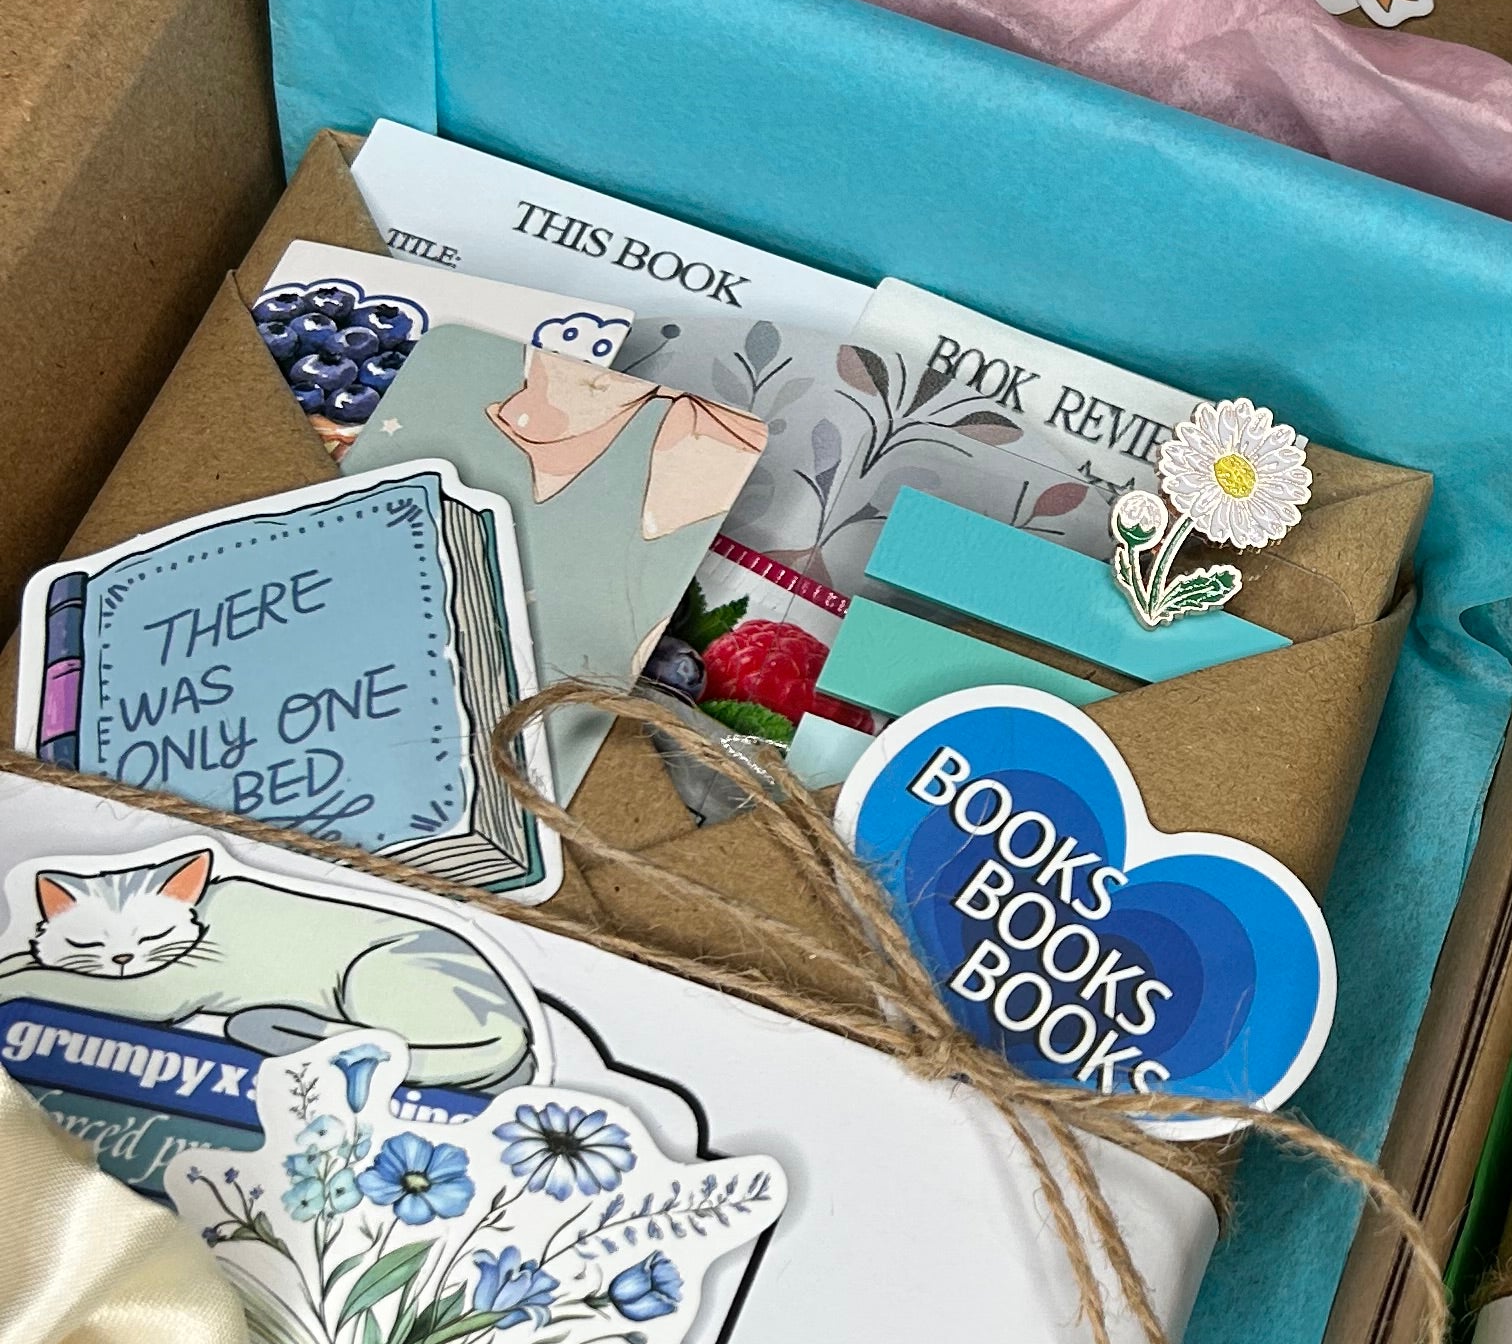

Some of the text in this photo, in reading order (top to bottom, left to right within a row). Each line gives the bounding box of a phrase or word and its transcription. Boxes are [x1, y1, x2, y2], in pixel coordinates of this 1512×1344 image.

[386, 227, 463, 269] TITLE:
[511, 199, 752, 309] THIS BOOK
[926, 335, 1174, 466] BOOK REVIE
[143, 569, 334, 665] THERE
[119, 664, 233, 732] WAS
[278, 664, 408, 744] ONE
[233, 749, 345, 815] BED
[906, 745, 1129, 921] BOOKS
[951, 859, 1175, 1037] BOOKS
[947, 937, 1172, 1096] BOOKS
